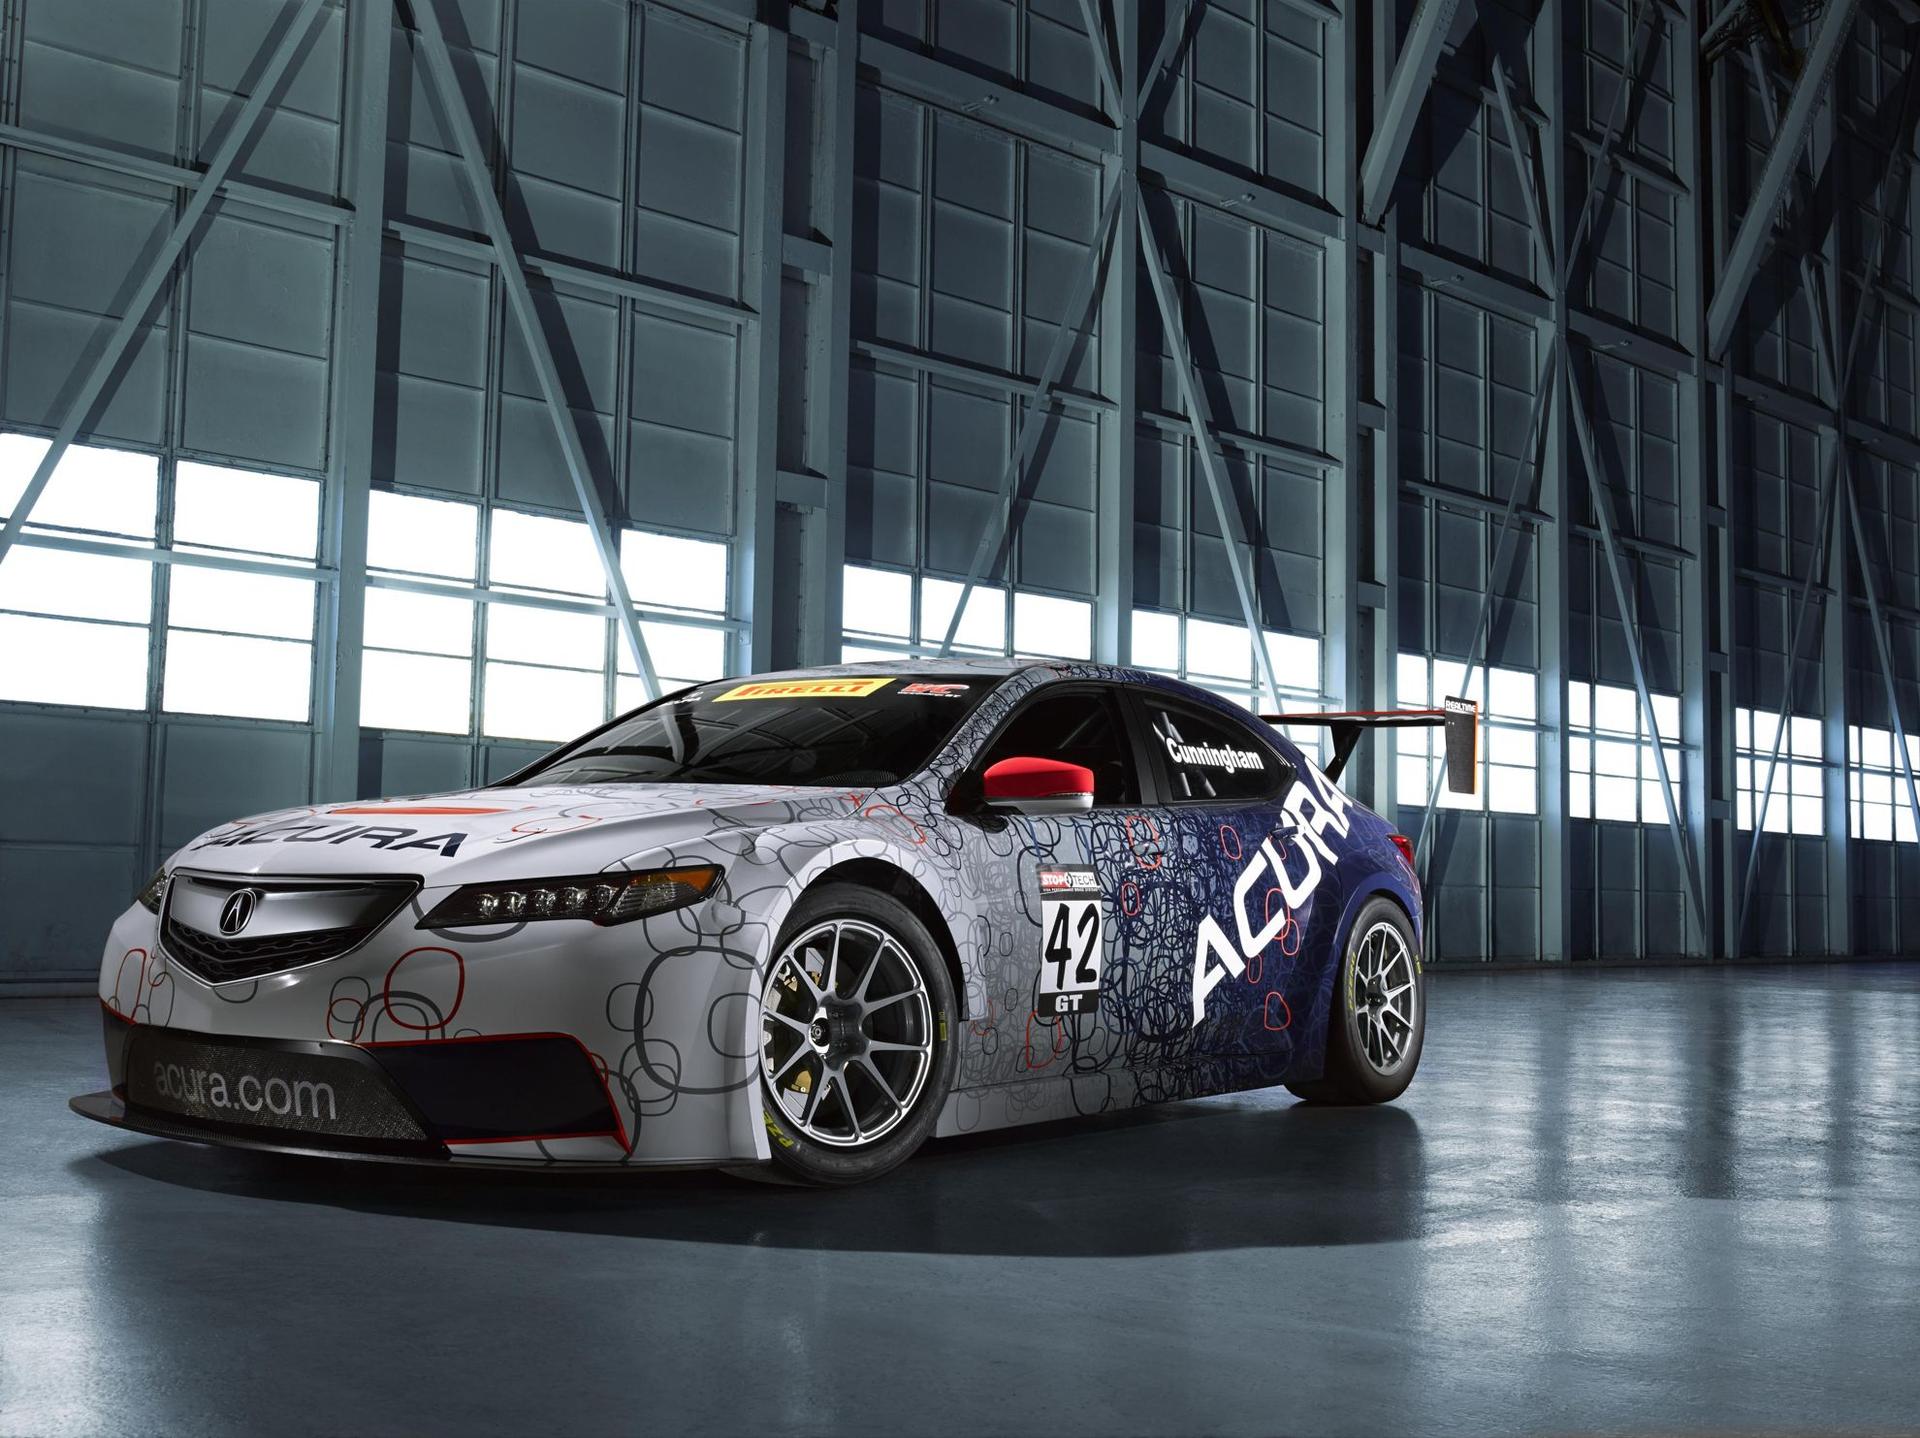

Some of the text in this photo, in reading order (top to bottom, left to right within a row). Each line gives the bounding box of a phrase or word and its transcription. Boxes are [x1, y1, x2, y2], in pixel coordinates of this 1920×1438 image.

[735, 682, 875, 697] PIRELLI
[1165, 737, 1265, 774] Cunningham
[190, 824, 468, 858] ACURA
[1192, 756, 1353, 1029] ACURA
[1045, 902, 1099, 991] 42
[1055, 994, 1083, 1013] GT
[154, 1061, 337, 1120] acura.com
